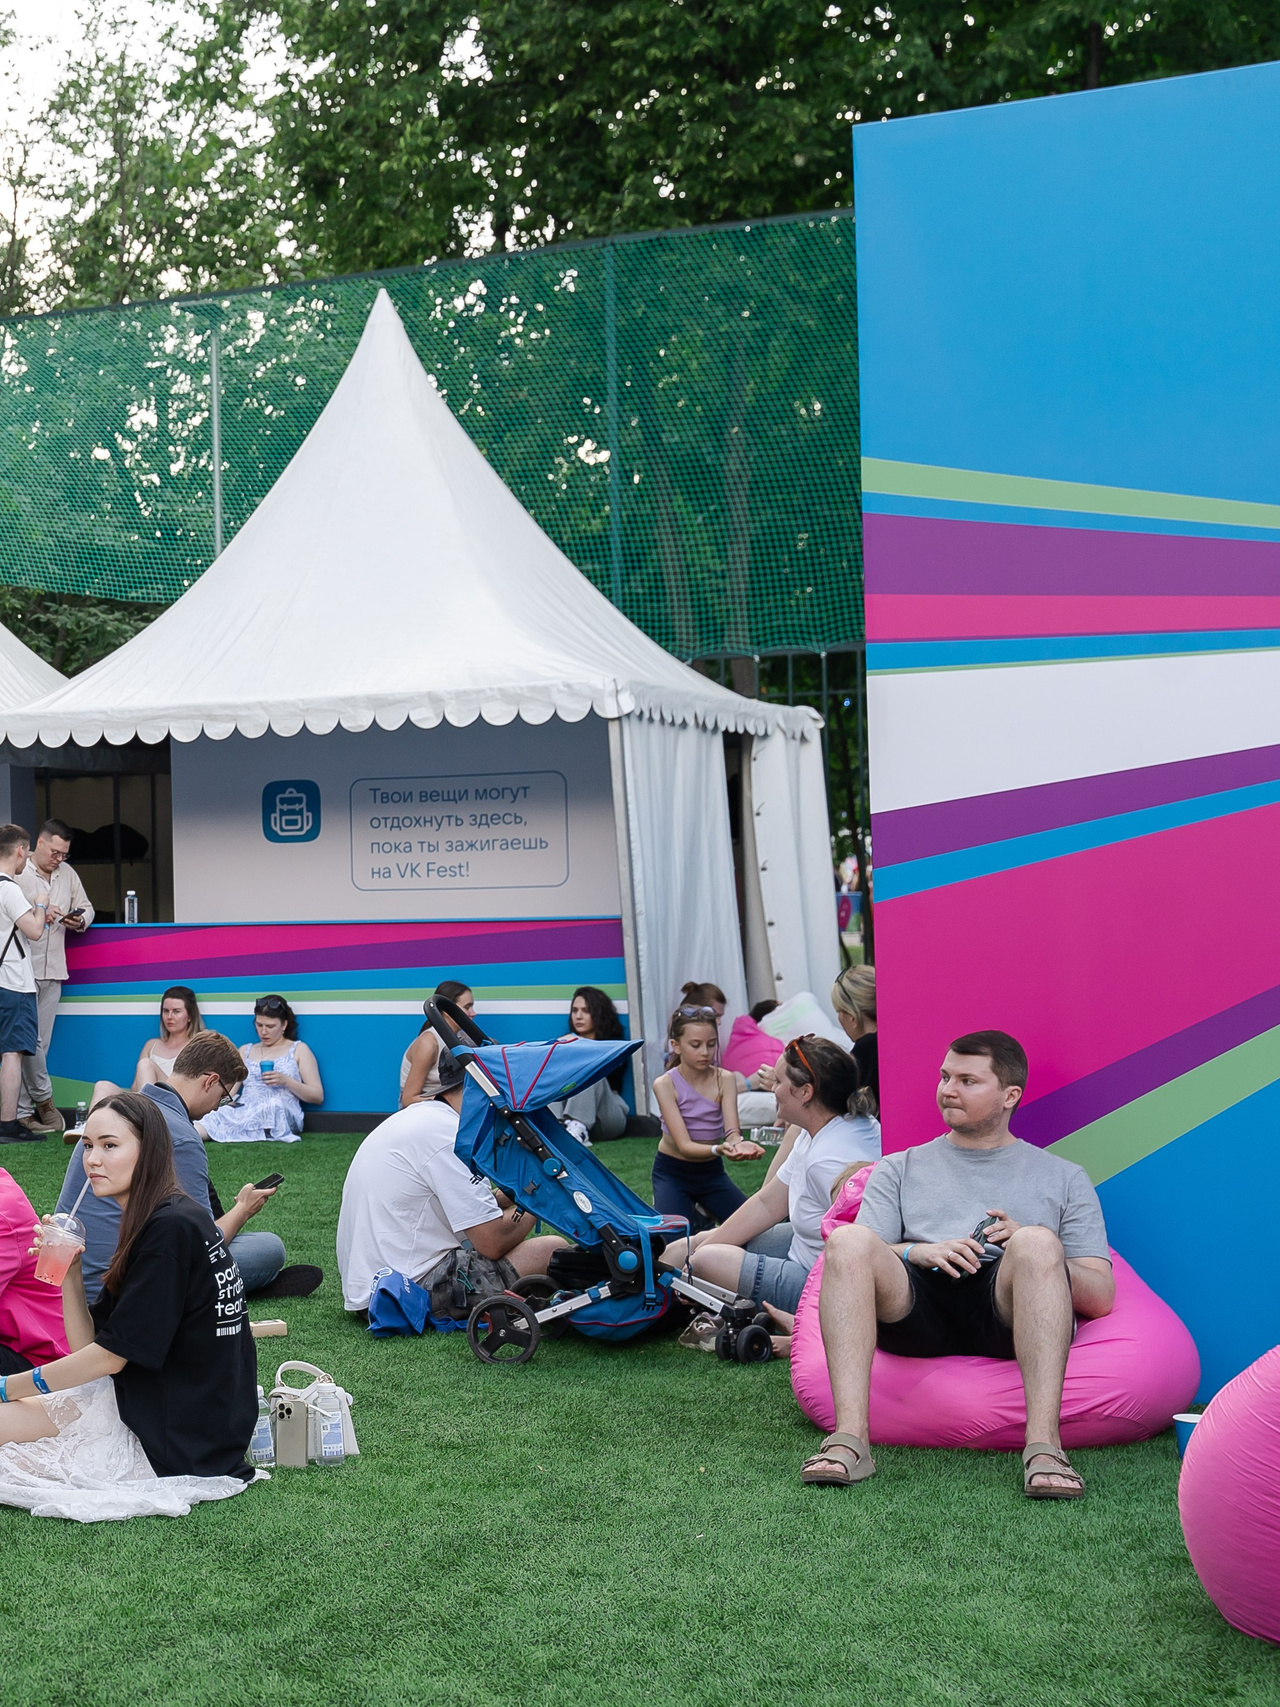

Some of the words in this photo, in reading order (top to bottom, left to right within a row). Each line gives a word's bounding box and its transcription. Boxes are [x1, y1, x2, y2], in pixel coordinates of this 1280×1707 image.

[369, 787, 414, 805] Твои
[419, 787, 469, 805] вещи
[474, 785, 530, 804] могут
[369, 814, 463, 831] отдохнуть
[469, 812, 528, 828] здесь,
[371, 840, 412, 854] пока
[417, 838, 440, 854] ты
[445, 836, 548, 853] зажигаешь
[371, 864, 392, 880] на
[395, 862, 422, 879] VK
[425, 860, 470, 878] Fest!
